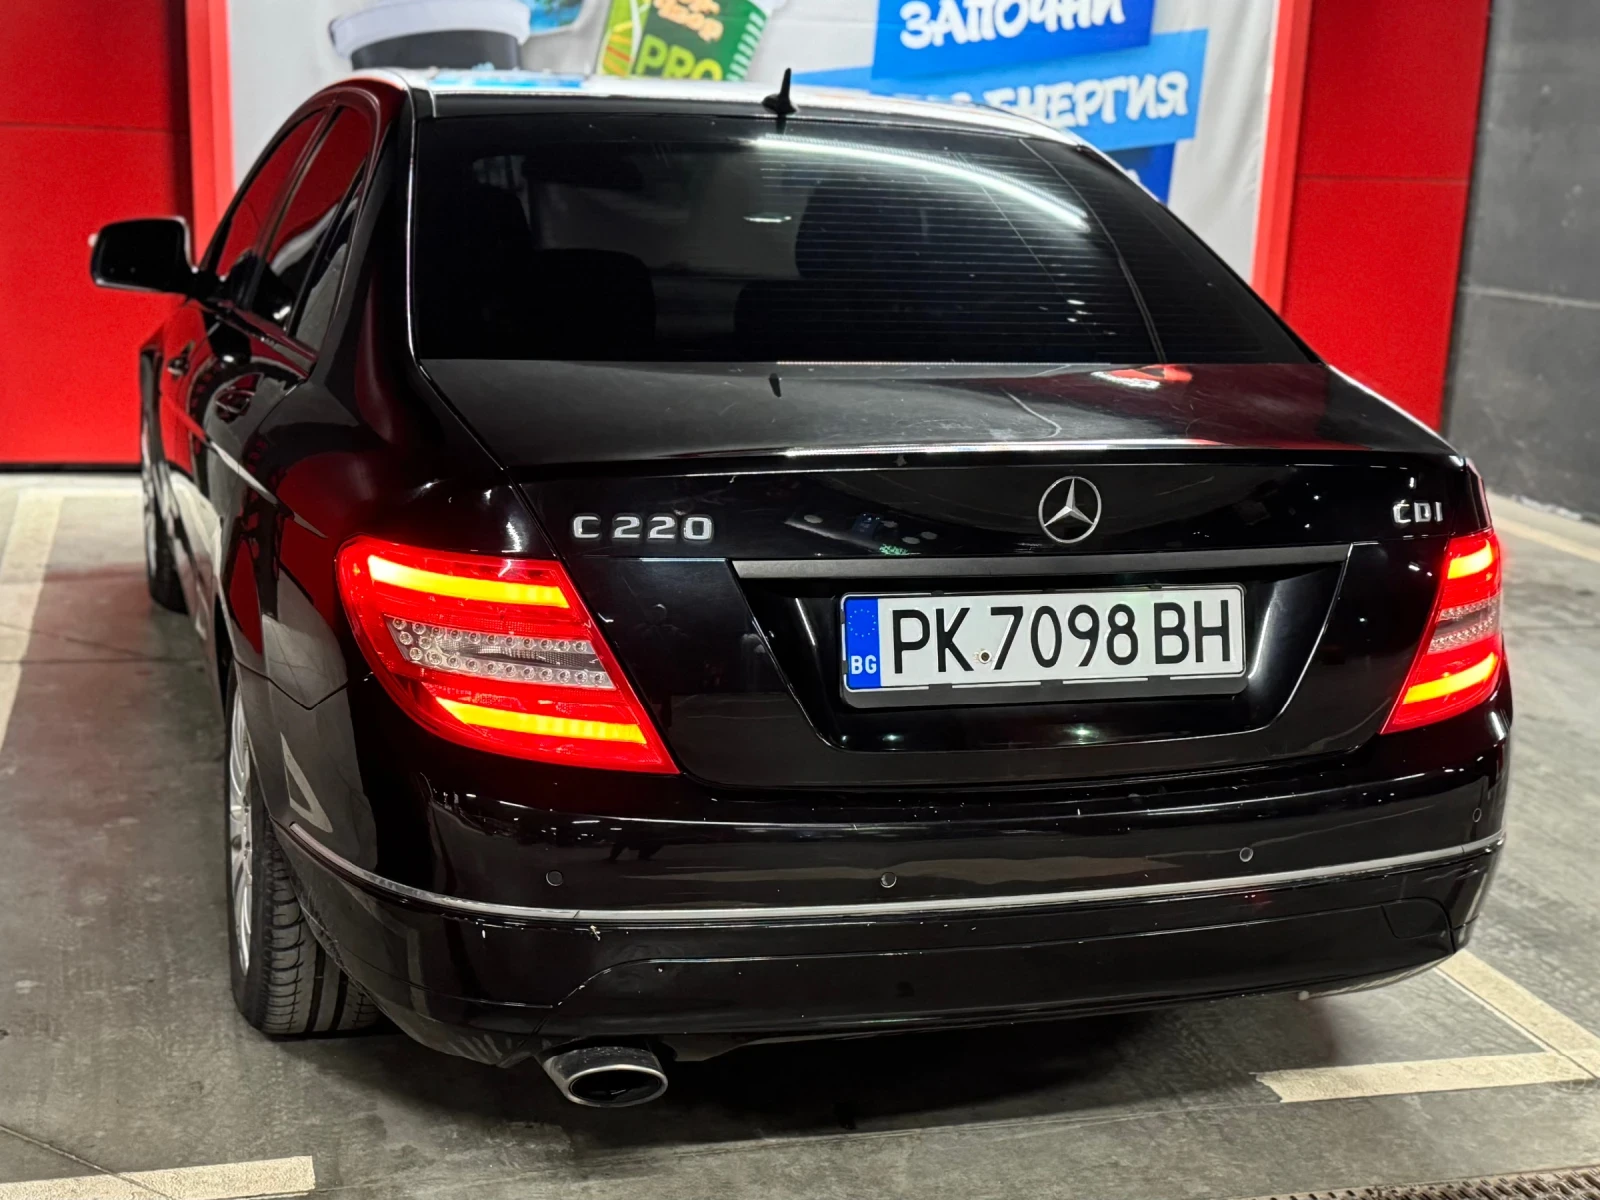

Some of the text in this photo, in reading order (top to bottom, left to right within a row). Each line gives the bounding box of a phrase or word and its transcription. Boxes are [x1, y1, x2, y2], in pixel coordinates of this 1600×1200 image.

[1393, 501, 1443, 523] CDI
[573, 515, 713, 541] C 220
[891, 599, 1232, 674] PK 7098 BH
[851, 655, 877, 676] BG
